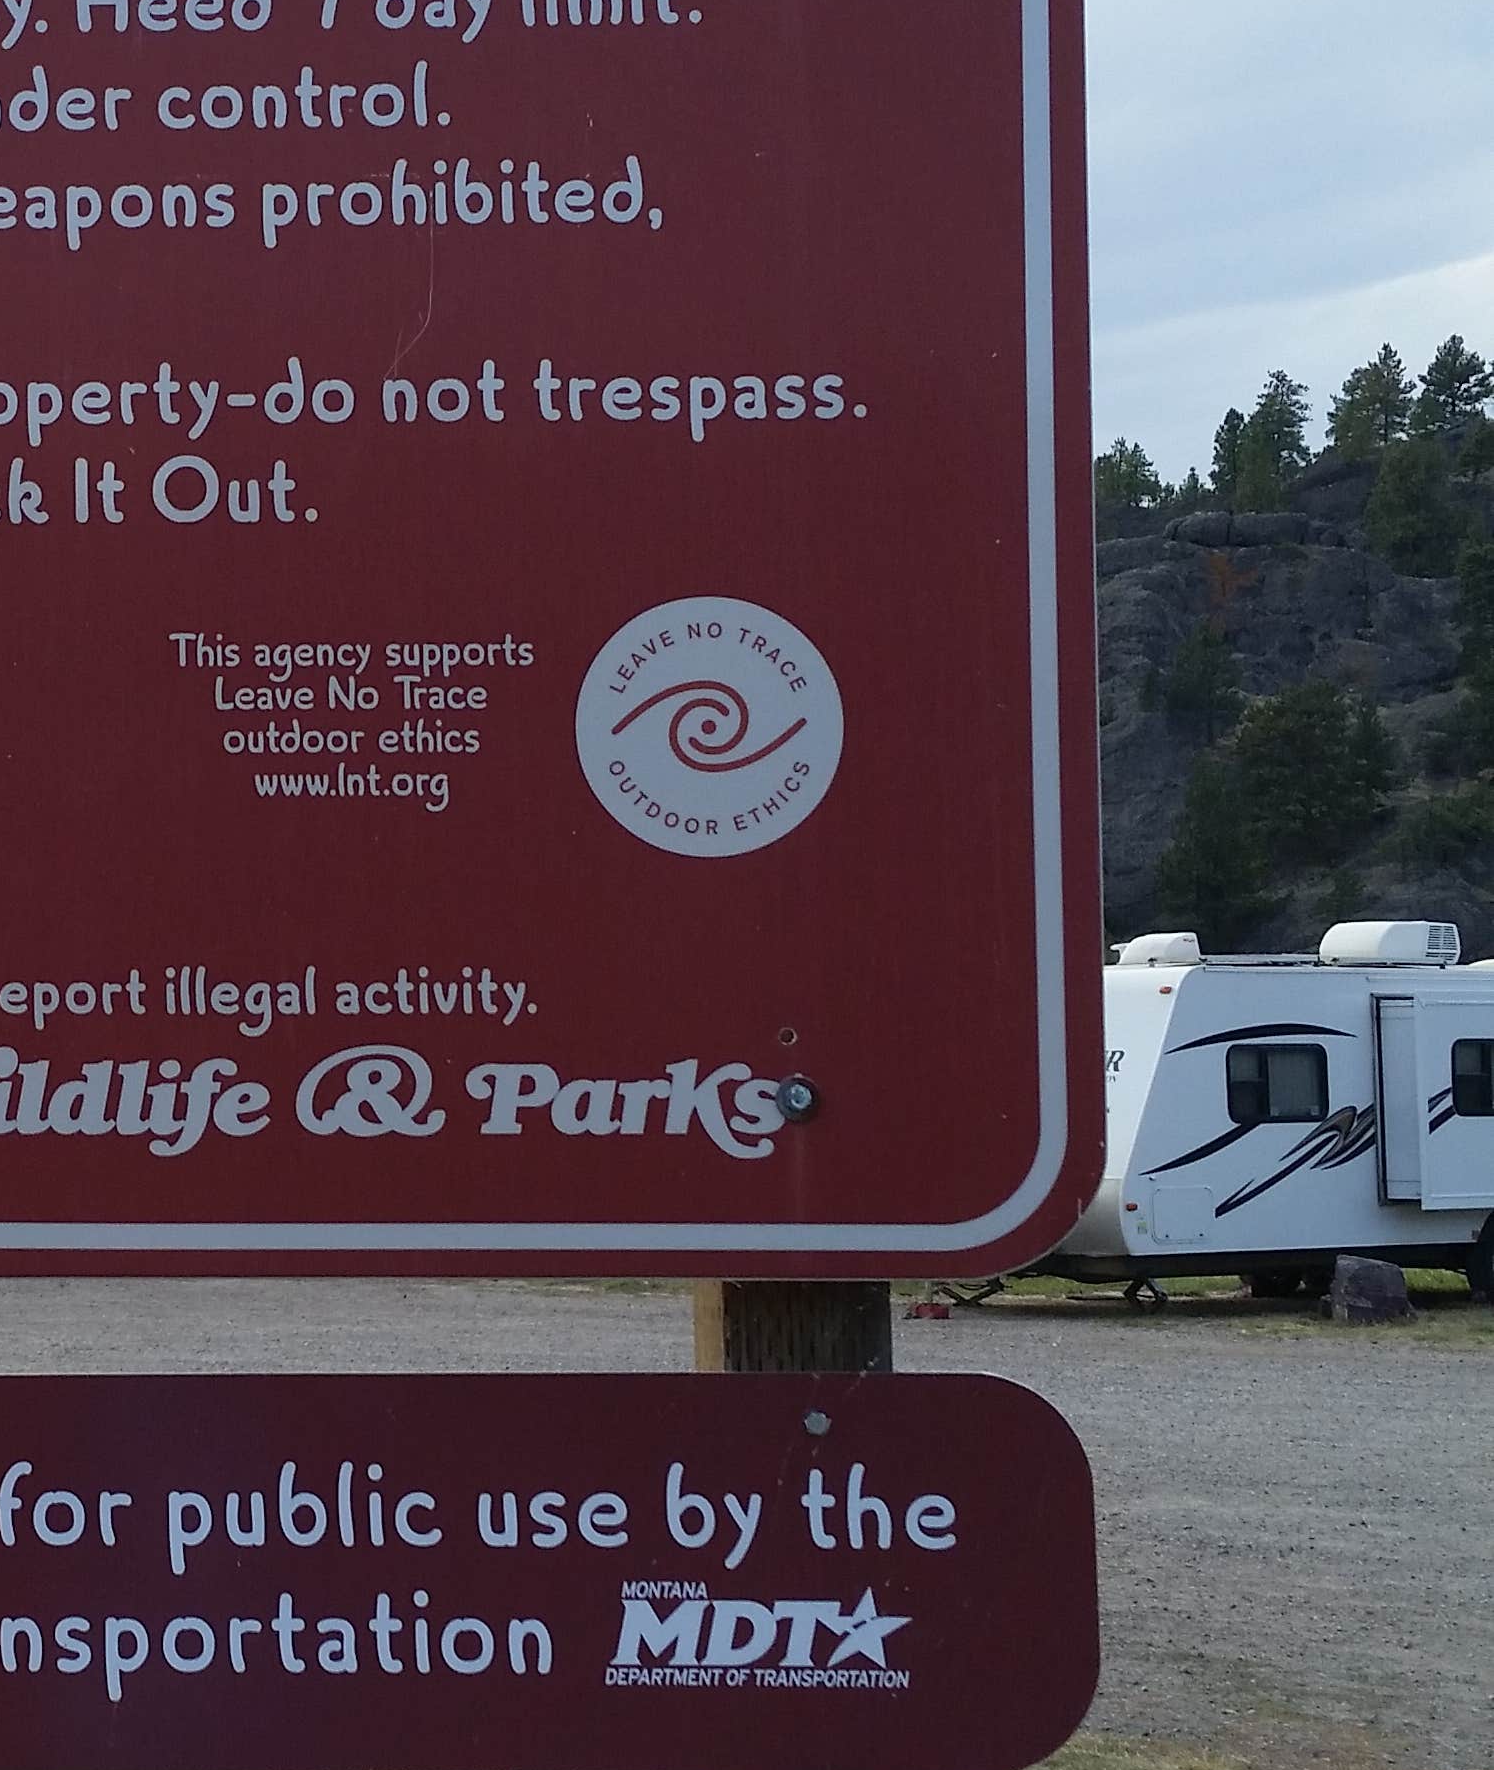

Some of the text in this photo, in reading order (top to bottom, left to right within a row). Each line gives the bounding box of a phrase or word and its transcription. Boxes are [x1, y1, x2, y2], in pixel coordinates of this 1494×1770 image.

[158, 61, 450, 129] control.
[263, 156, 662, 248] prohibited,
[383, 360, 504, 422] not
[534, 359, 866, 442] trespass.
[75, 458, 124, 523] It
[153, 455, 317, 522] Out.
[169, 633, 533, 682] This agency supports
[610, 622, 807, 693] LEAVE NO TRACE
[216, 676, 487, 710] Leave No Trace
[224, 719, 479, 753] outdoor ethics
[255, 763, 448, 812] www.lnt.org
[609, 760, 810, 835] OUTDOOR ETHICS
[166, 966, 315, 1036] illegal
[336, 967, 537, 1025] activity.
[296, 1045, 446, 1137] &
[466, 1059, 785, 1159] Parks
[169, 1462, 442, 1574] public
[479, 1492, 628, 1547] use
[667, 1463, 761, 1569] by
[802, 1463, 956, 1549] the
[621, 1581, 708, 1600] MONTANA
[609, 1599, 841, 1667] MDT
[605, 1667, 910, 1689] DEPARTMENT OF TRANSPORTATION
